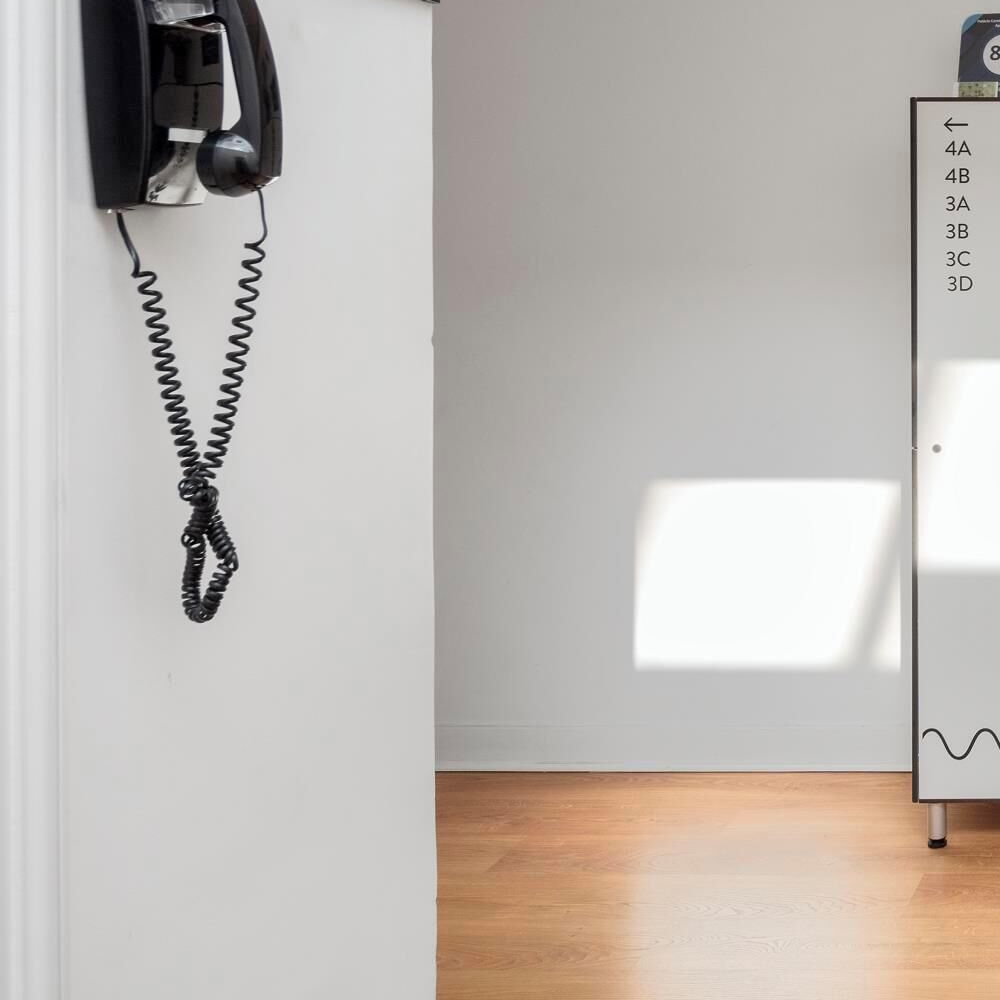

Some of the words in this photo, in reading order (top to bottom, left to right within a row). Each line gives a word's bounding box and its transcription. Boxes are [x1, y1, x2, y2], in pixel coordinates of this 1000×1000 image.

[945, 141, 971, 156] 4A
[945, 168, 970, 183] 4B
[945, 196, 970, 211] 3A
[946, 224, 969, 239] 3B
[946, 251, 970, 266] 3C
[947, 276, 973, 291] 3D
